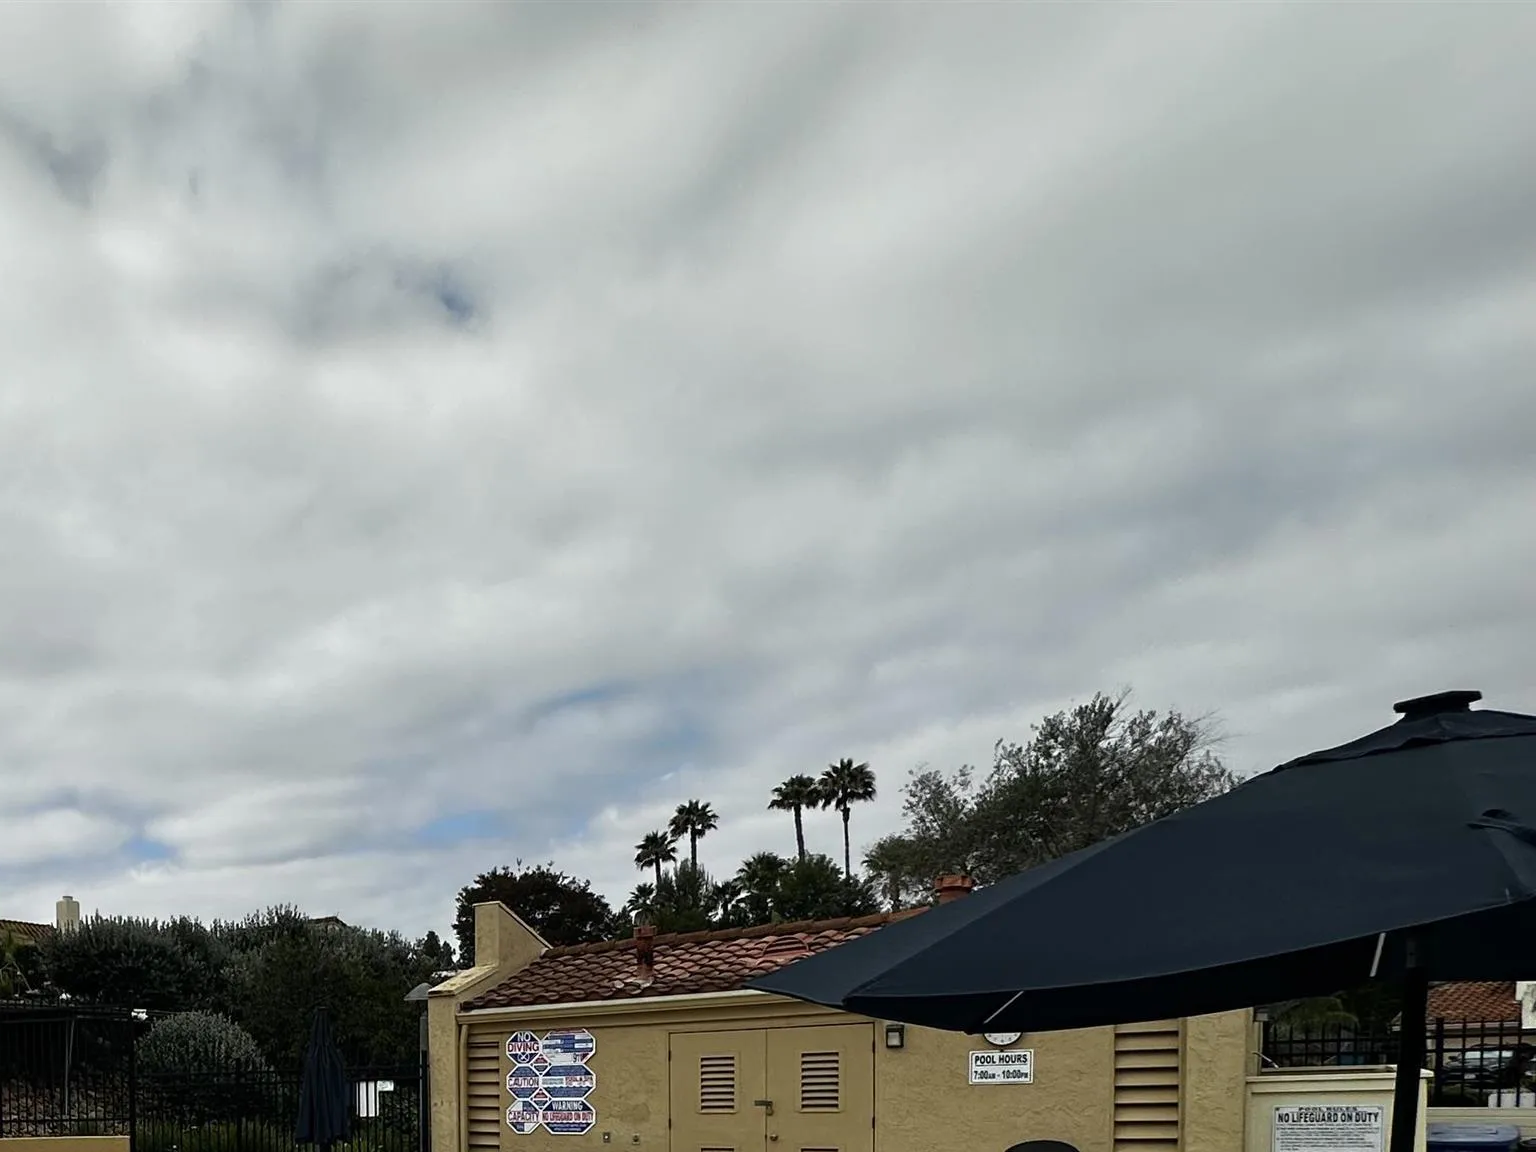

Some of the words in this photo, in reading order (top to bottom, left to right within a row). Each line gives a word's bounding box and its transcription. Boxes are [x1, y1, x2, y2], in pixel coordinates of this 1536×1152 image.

[517, 1032, 531, 1041] NO
[508, 1042, 540, 1052] DIVING
[974, 1055, 996, 1064] POOL
[999, 1054, 1028, 1063] HOURS
[974, 1071, 996, 1079] 7:00AM
[1002, 1070, 1028, 1079] 10:00PM
[508, 1077, 540, 1087] CAUTION
[551, 1101, 583, 1110] WARNING
[508, 1110, 540, 1120] CAPACITY
[550, 1112, 573, 1121] LIFEGUARD
[574, 1112, 581, 1121] ON
[1278, 1112, 1290, 1122] NO
[1291, 1112, 1338, 1122] LIFEGUARD
[1340, 1112, 1353, 1122] ON
[1355, 1112, 1379, 1122] DUTY
